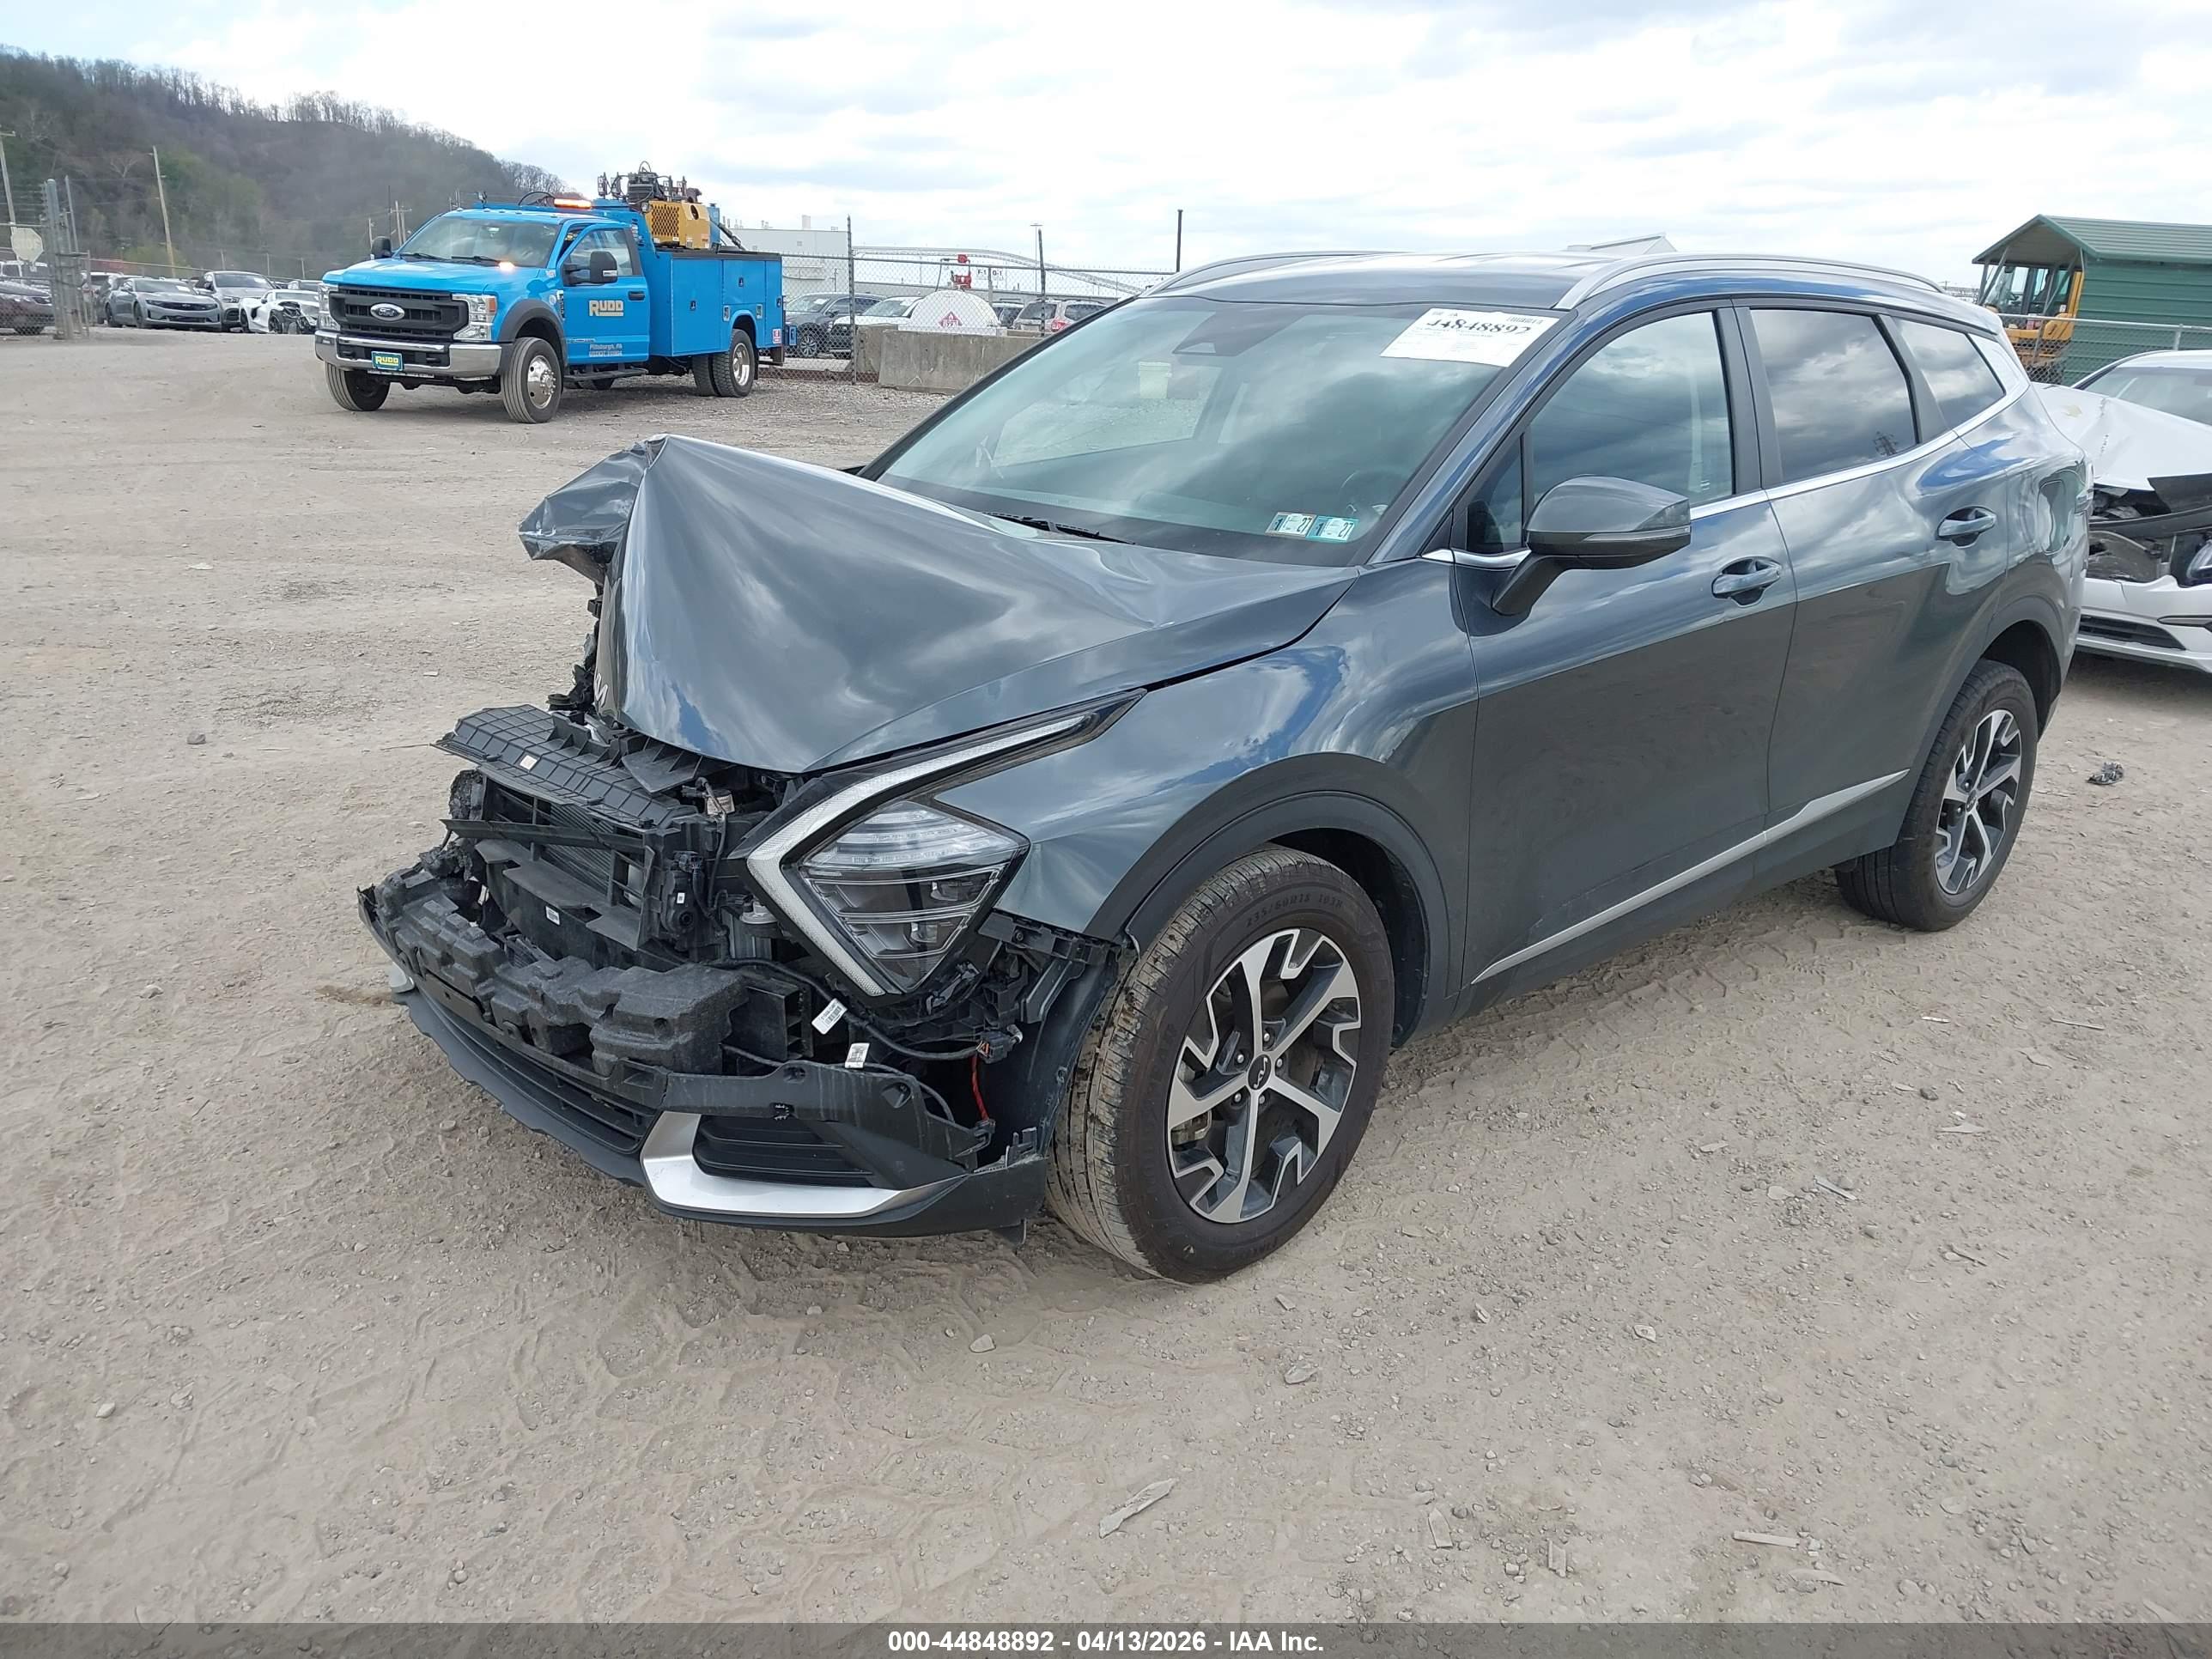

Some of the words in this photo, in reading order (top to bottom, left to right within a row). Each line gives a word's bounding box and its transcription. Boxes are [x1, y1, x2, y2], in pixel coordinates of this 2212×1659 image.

[589, 300, 624, 317] RUDD
[374, 356, 399, 367] RUDD
[1297, 517, 1313, 534] 27
[1338, 522, 1354, 538] 27
